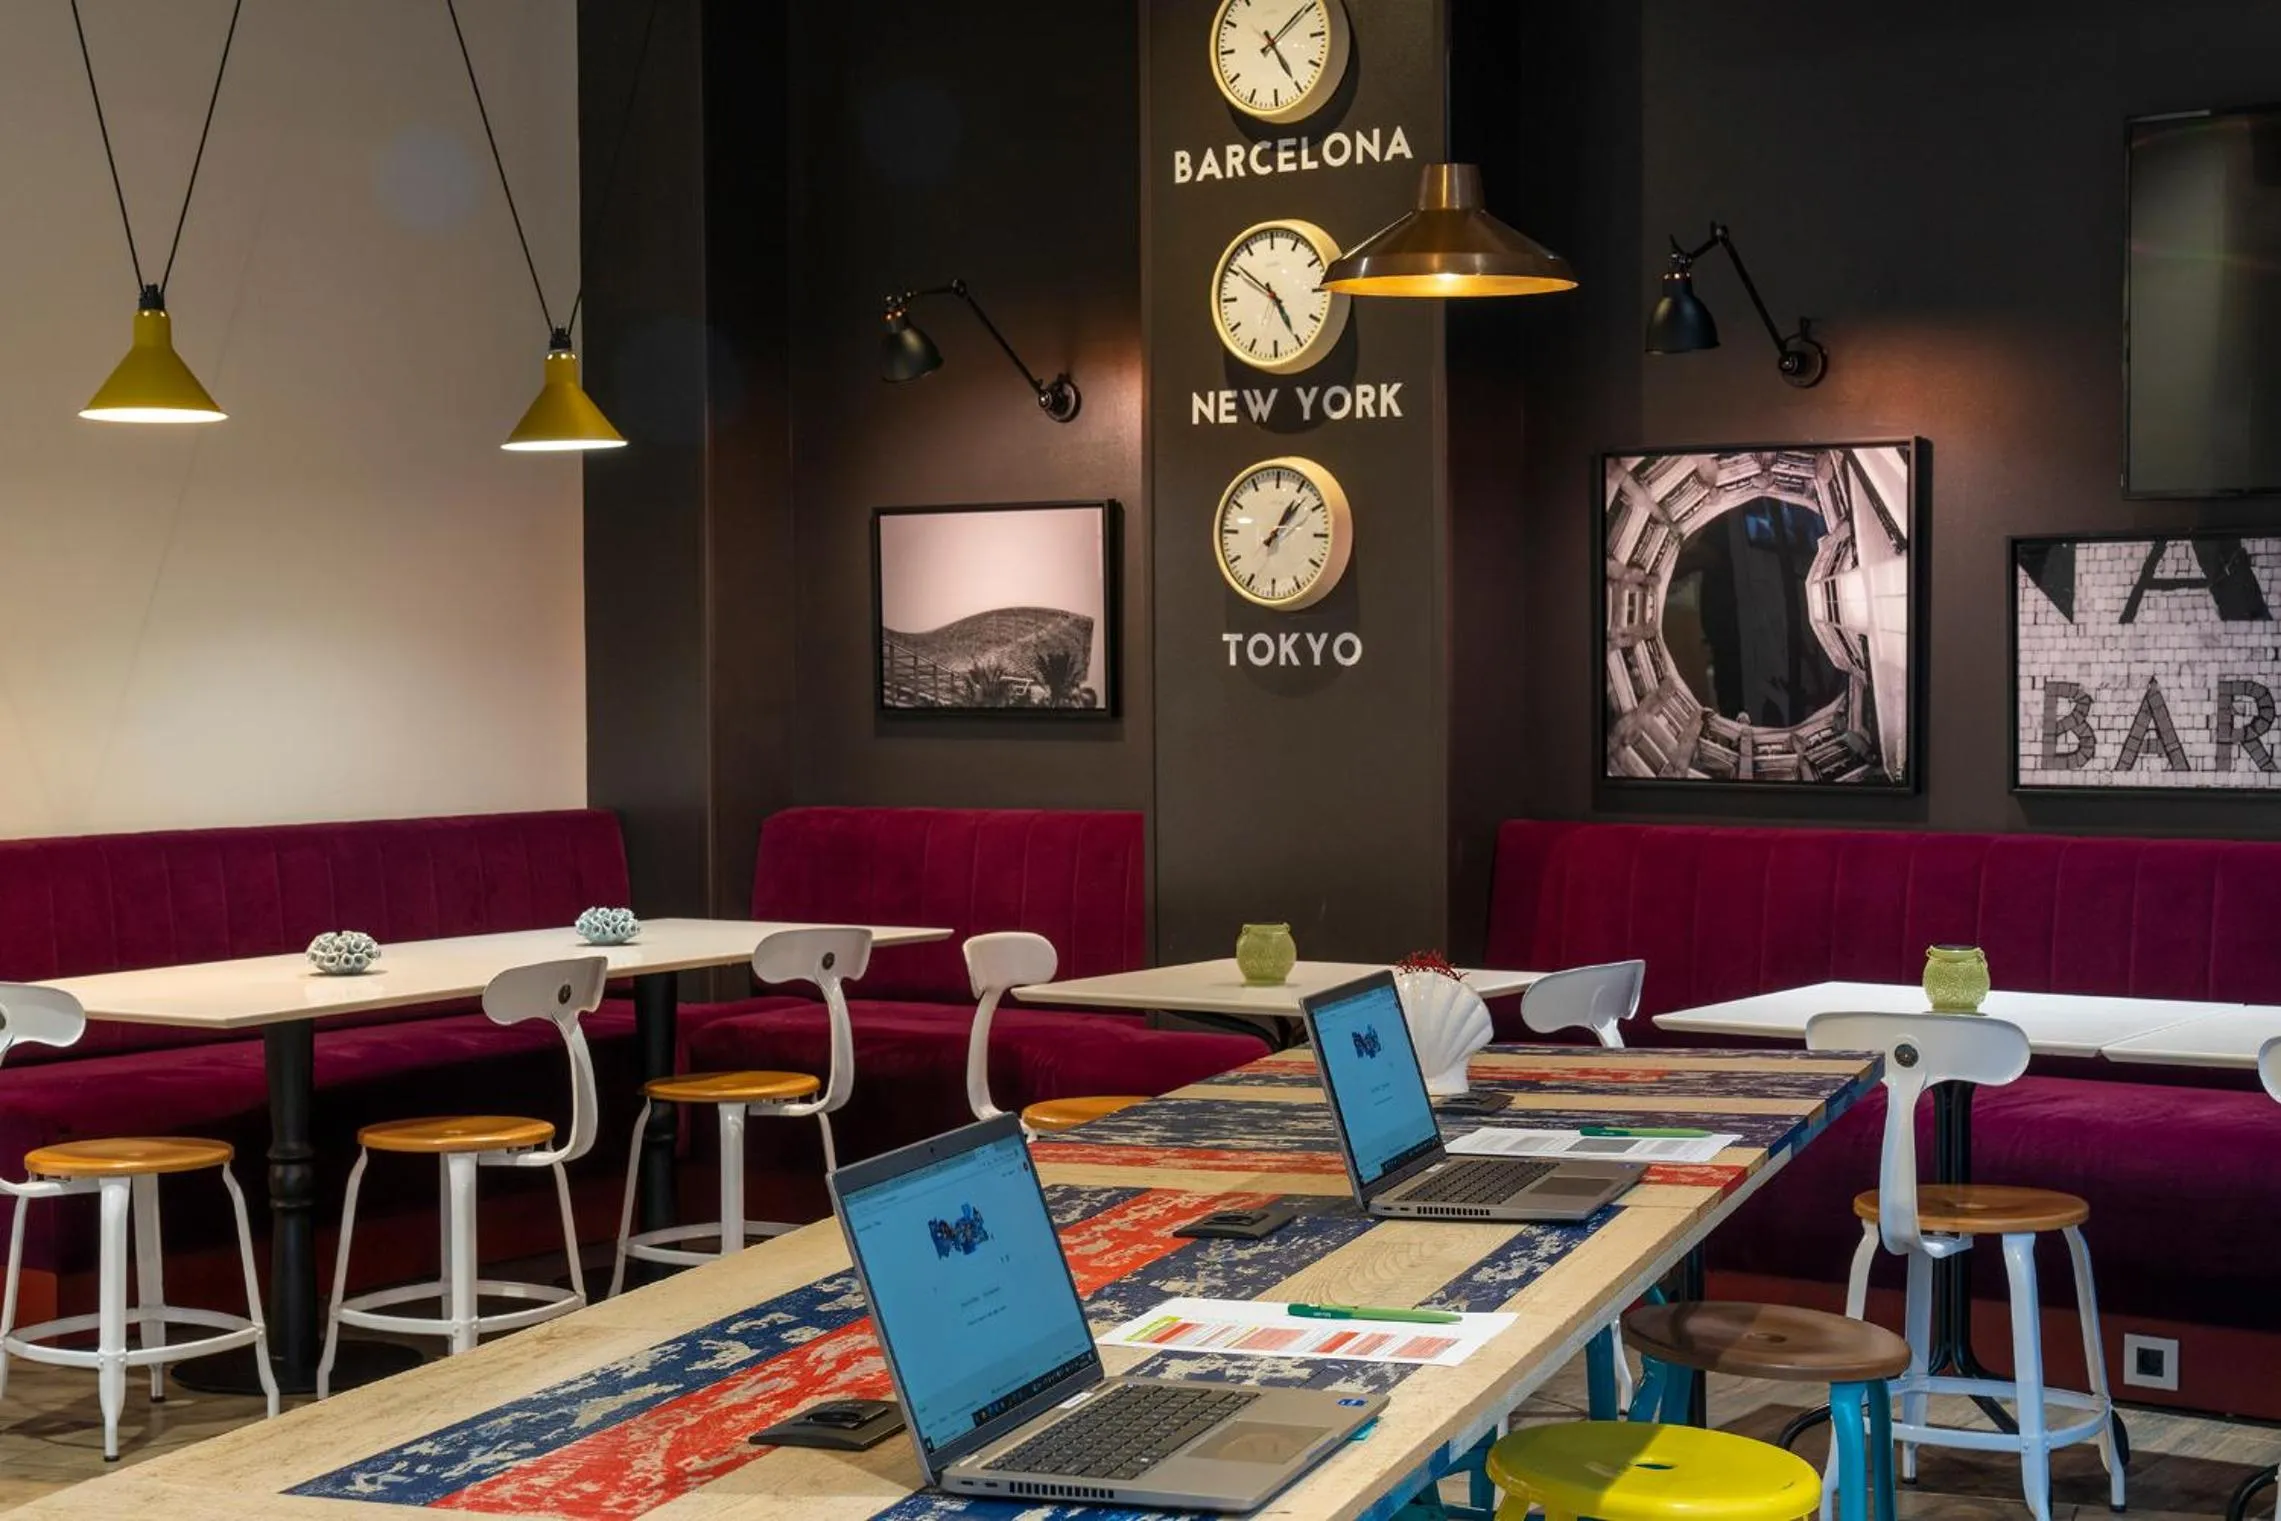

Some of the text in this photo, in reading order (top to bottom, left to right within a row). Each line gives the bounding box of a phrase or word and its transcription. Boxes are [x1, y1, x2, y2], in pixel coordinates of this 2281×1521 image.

[1174, 126, 1414, 184] BARCELONA
[1191, 383, 1403, 425] NEW YORK
[1221, 632, 1363, 667] TOKYO
[2041, 676, 2281, 772] BAR
